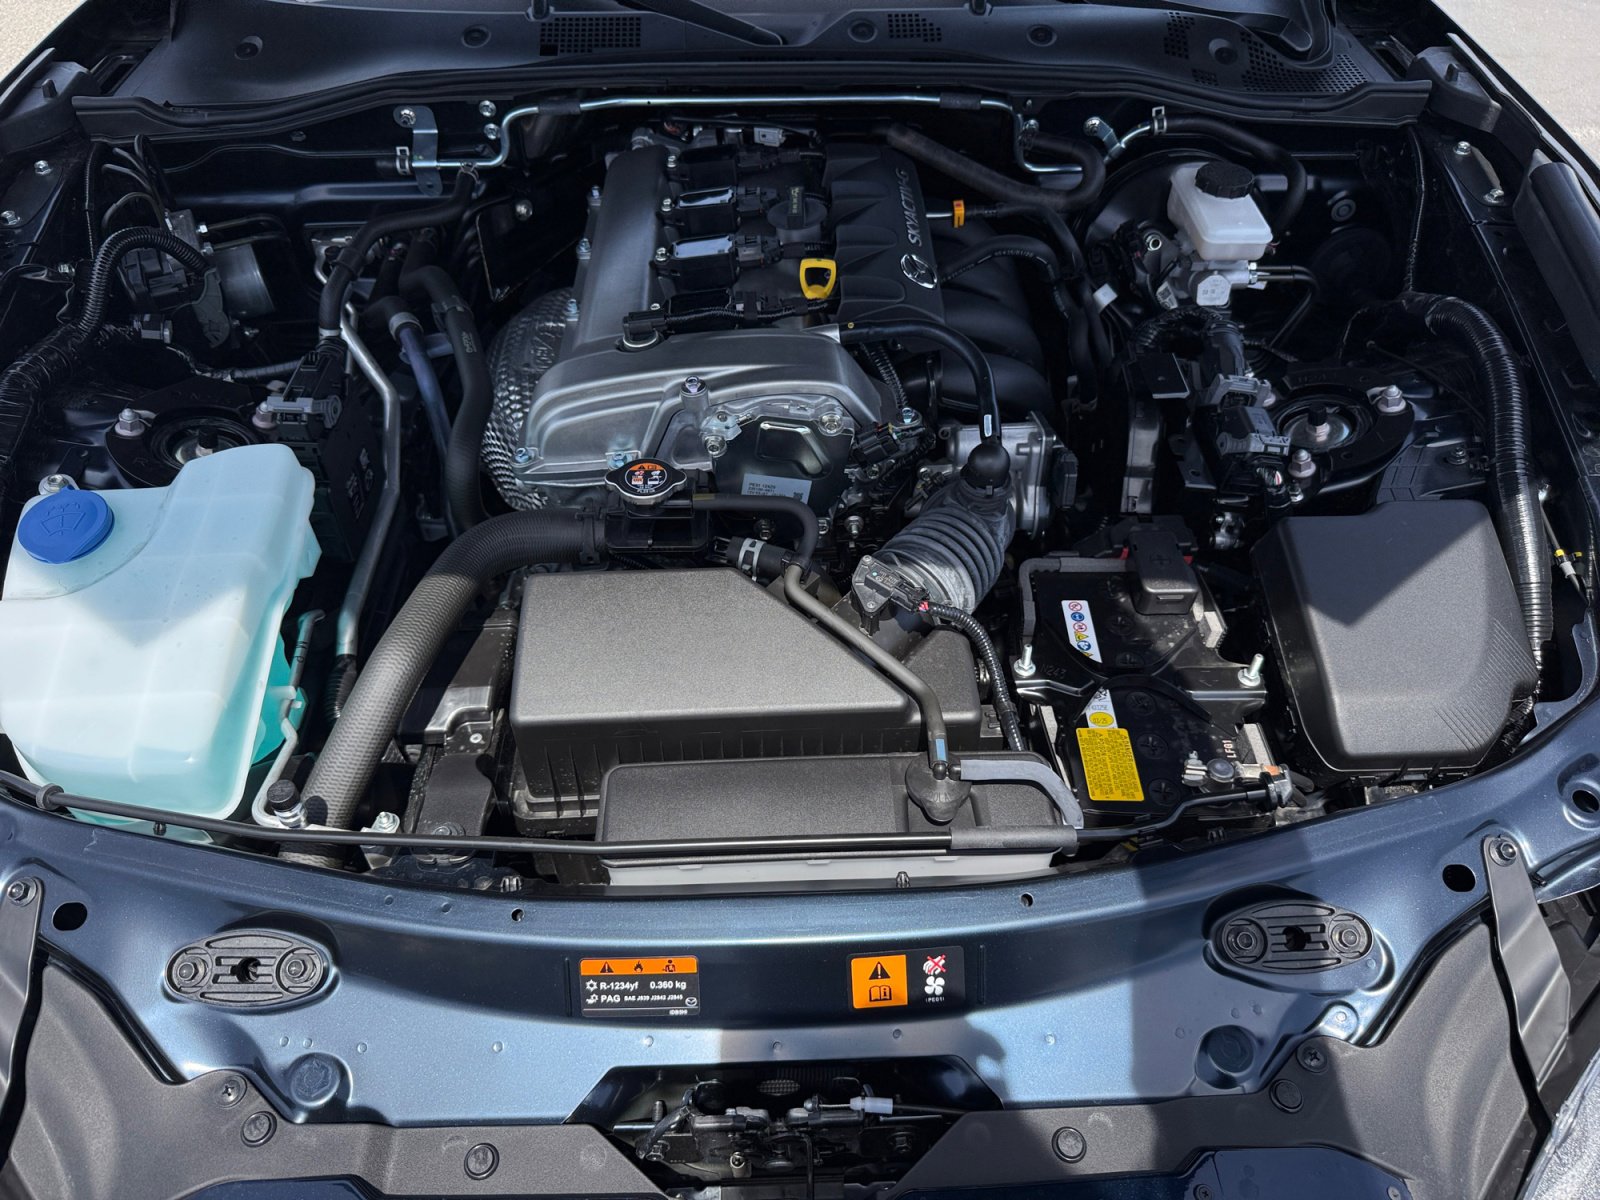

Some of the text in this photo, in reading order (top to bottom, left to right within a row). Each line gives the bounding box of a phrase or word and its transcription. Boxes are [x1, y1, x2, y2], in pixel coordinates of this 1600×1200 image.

[894, 168, 922, 247] SKYACTIV-G
[599, 980, 687, 991] R-1234yf 0.360 kg
[600, 994, 621, 1003] PAG
